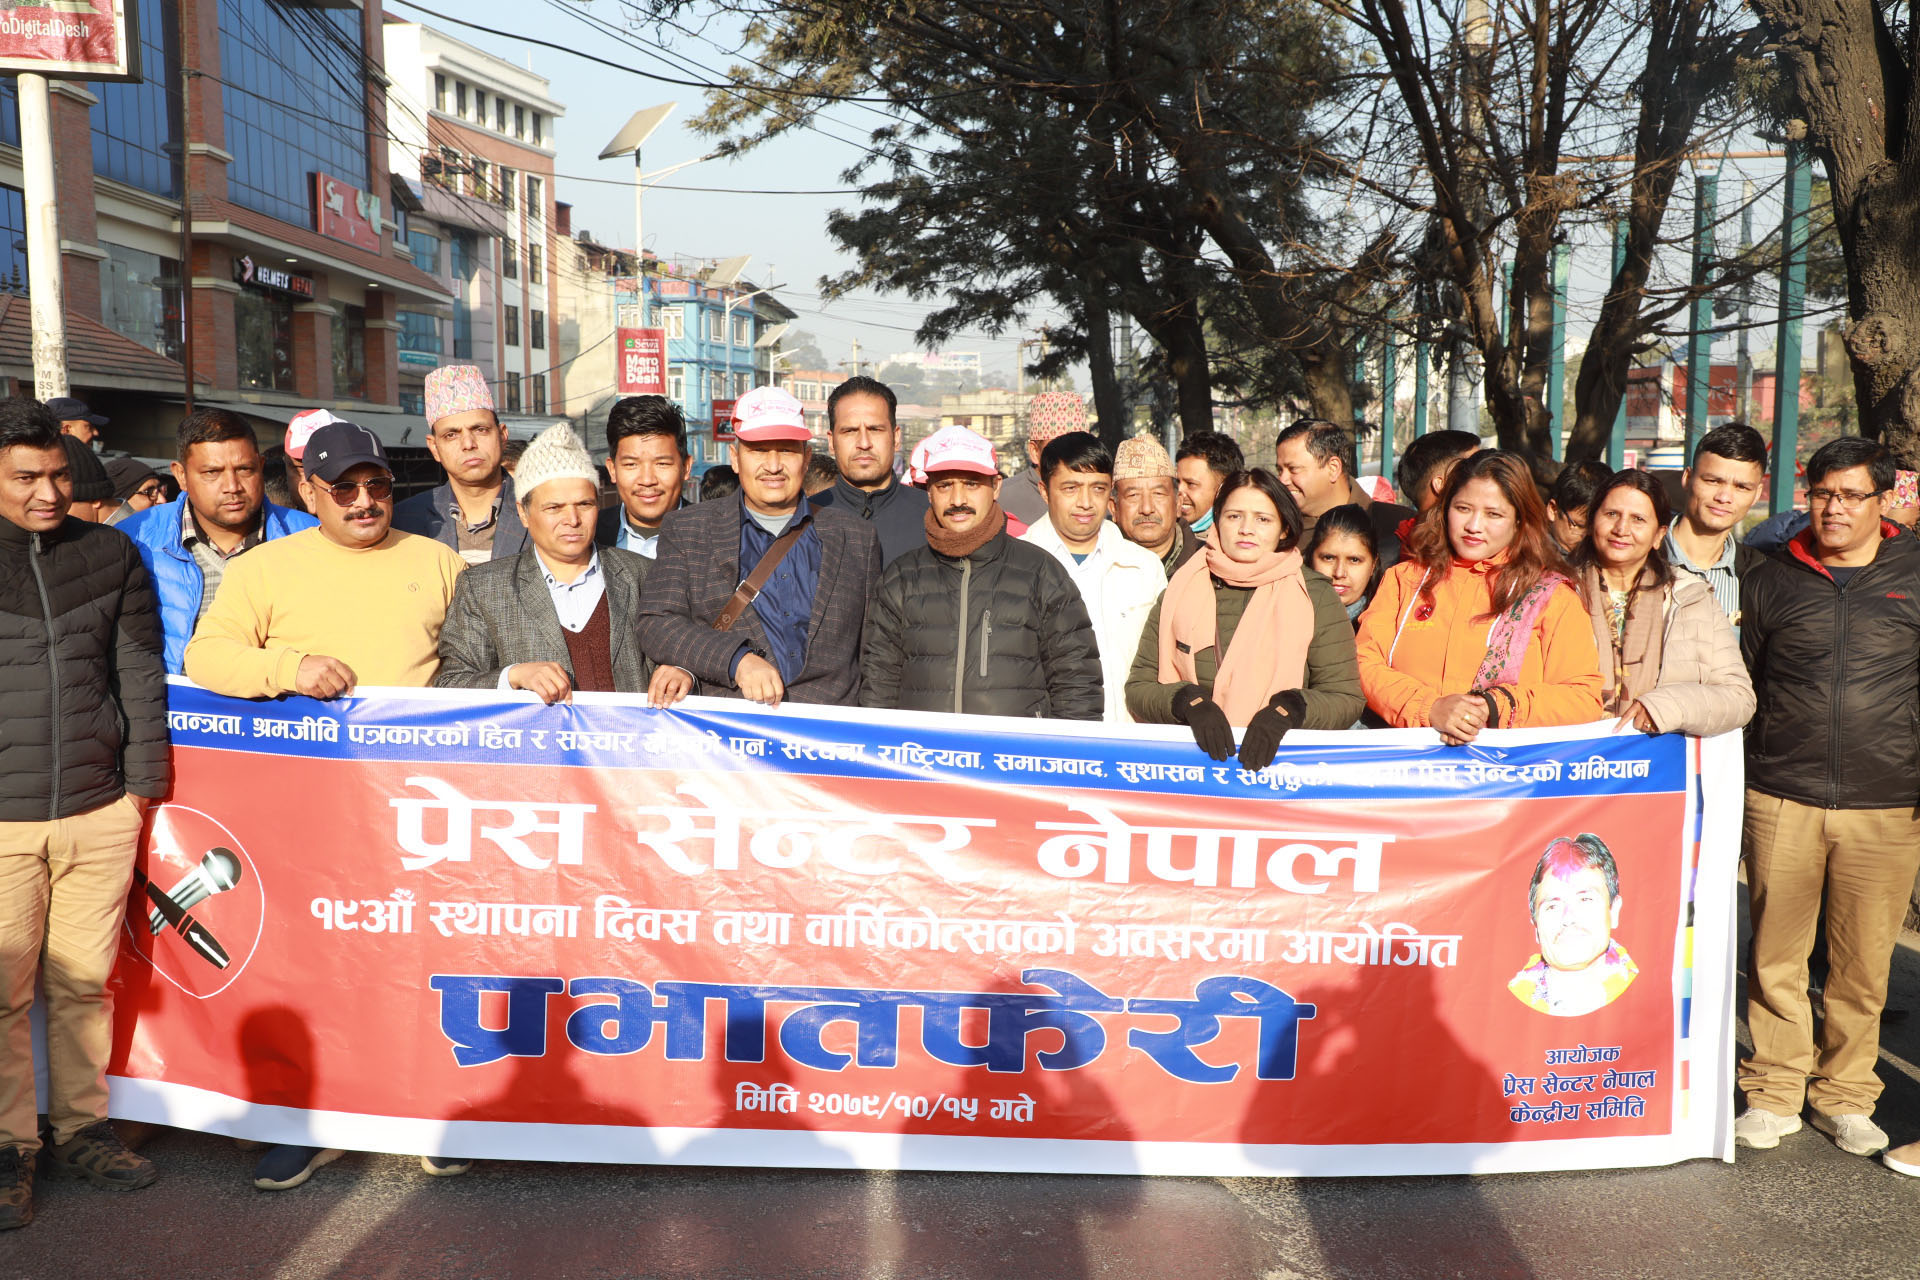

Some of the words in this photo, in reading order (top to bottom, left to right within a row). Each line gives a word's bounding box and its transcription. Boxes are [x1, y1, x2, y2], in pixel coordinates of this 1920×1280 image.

[0, 17, 89, 39] oDigitalDesh
[257, 266, 289, 289] HELMETS
[626, 354, 659, 367] Mero
[626, 364, 659, 376] Digital
[626, 372, 660, 385] Desh
[253, 716, 340, 743] श्रमजीवि
[348, 718, 474, 747] पत्रकारको
[478, 724, 523, 750] हित
[530, 729, 549, 751] र
[877, 742, 985, 770] राष्ट्रियता,
[993, 752, 1107, 778] समाजवाद,
[1116, 760, 1206, 784] सुशासन
[1213, 766, 1229, 785] र
[1464, 759, 1563, 785] सेन्टरको
[1568, 755, 1652, 781] अभियान
[388, 776, 597, 872] प्रेस
[637, 781, 997, 884] सेन्टर
[1035, 803, 1396, 894] नेपाल
[429, 901, 581, 938] स्थापना
[594, 895, 701, 945] दिवस
[713, 910, 794, 946] तथा
[805, 903, 1081, 954] वार्षिकोत्सवको
[1091, 922, 1269, 963] अवसरमा
[1281, 921, 1463, 968] आयोजित
[429, 968, 1317, 1084] प्रभातफेरी
[1545, 1044, 1622, 1065] आयोजक
[1503, 1073, 1536, 1097] प्रेस
[1541, 1071, 1598, 1095] सेन्टर
[1602, 1068, 1656, 1089] नेपाल
[735, 1081, 800, 1113] मिति
[989, 1093, 1037, 1122] गते
[1509, 1100, 1580, 1125] केन्द्रीय
[1586, 1095, 1646, 1120] समिति
